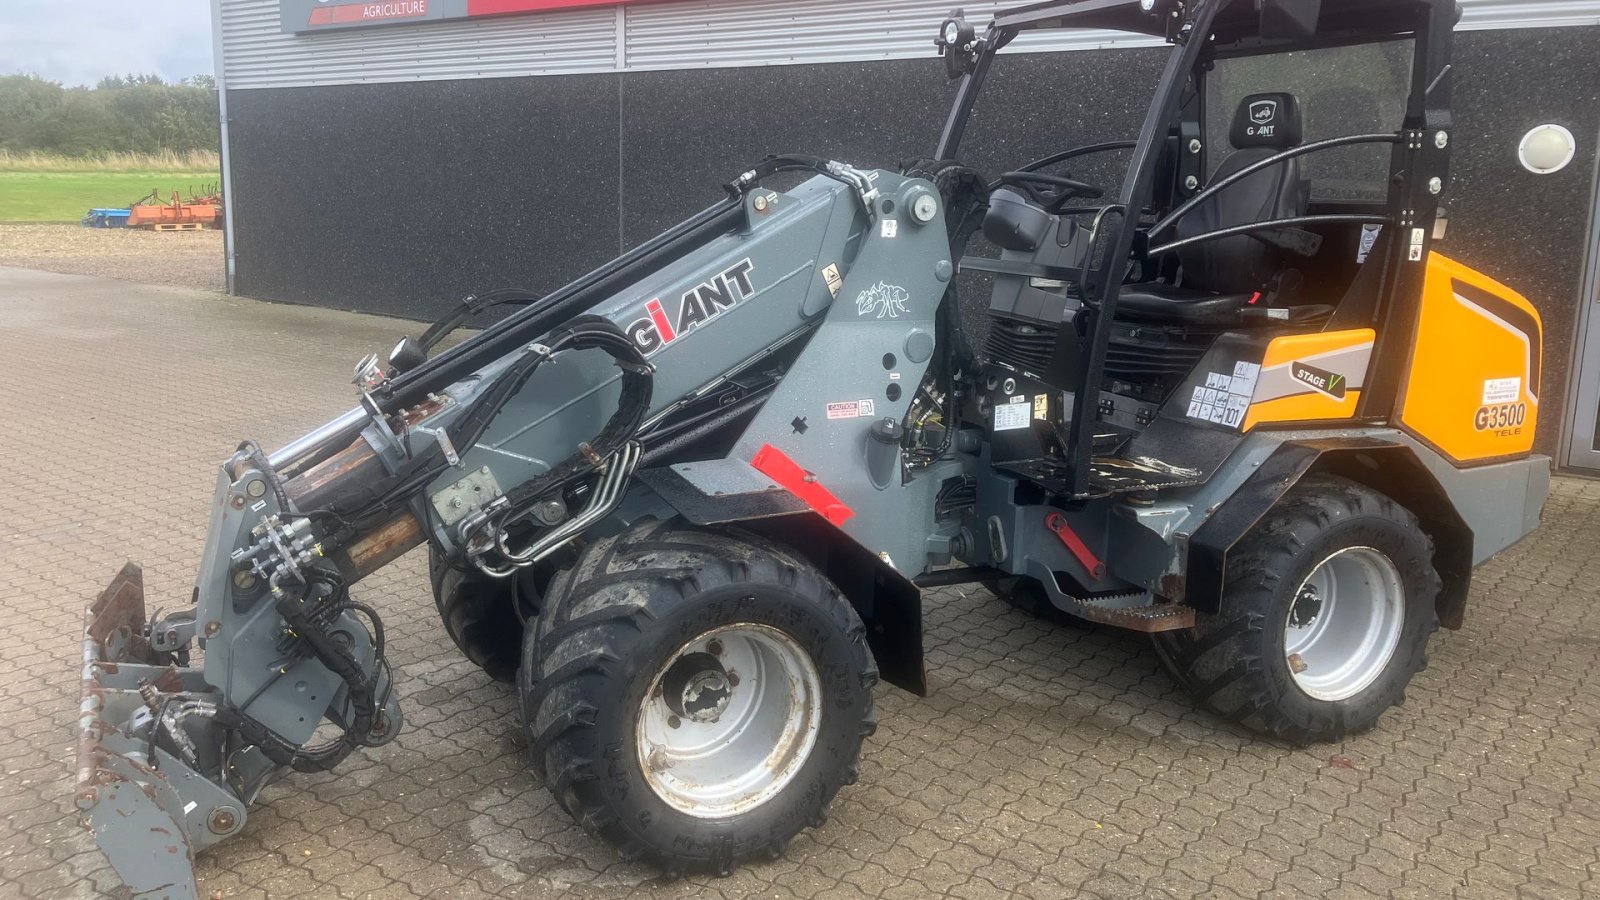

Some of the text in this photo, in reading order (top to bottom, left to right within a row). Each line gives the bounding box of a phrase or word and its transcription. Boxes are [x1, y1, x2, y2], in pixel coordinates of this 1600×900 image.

[363, 1, 425, 18] AGRICULTURE
[1297, 369, 1344, 391] STAGE V
[832, 402, 855, 410] CAUTION
[1225, 407, 1240, 425] 101
[1475, 402, 1526, 431] G3500
[1495, 428, 1521, 437] TELE
